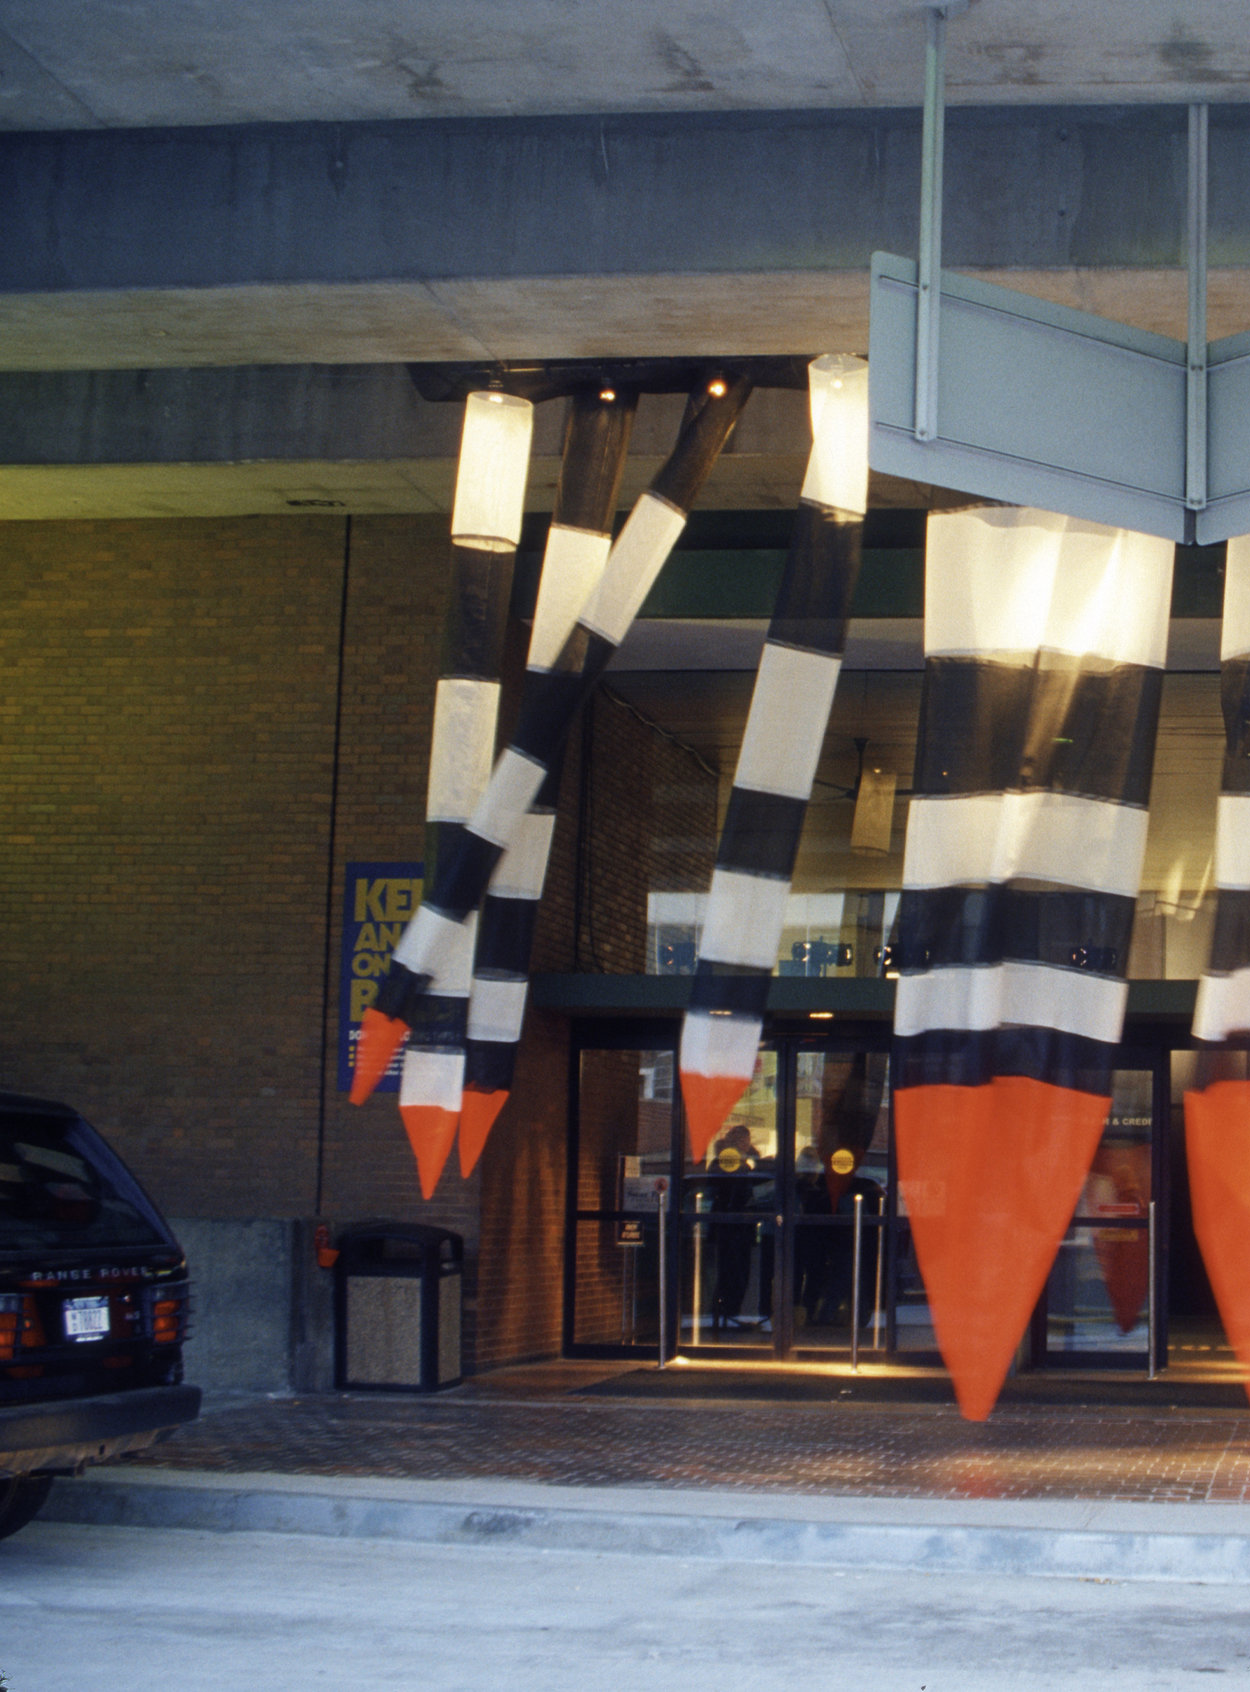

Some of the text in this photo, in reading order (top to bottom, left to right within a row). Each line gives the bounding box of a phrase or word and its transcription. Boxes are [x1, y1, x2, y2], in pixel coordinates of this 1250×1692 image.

[354, 878, 423, 922] KE
[353, 923, 401, 952] AN
[351, 952, 391, 977] ON
[1122, 1118, 1152, 1126] CREDI
[31, 1269, 91, 1281] RANGE
